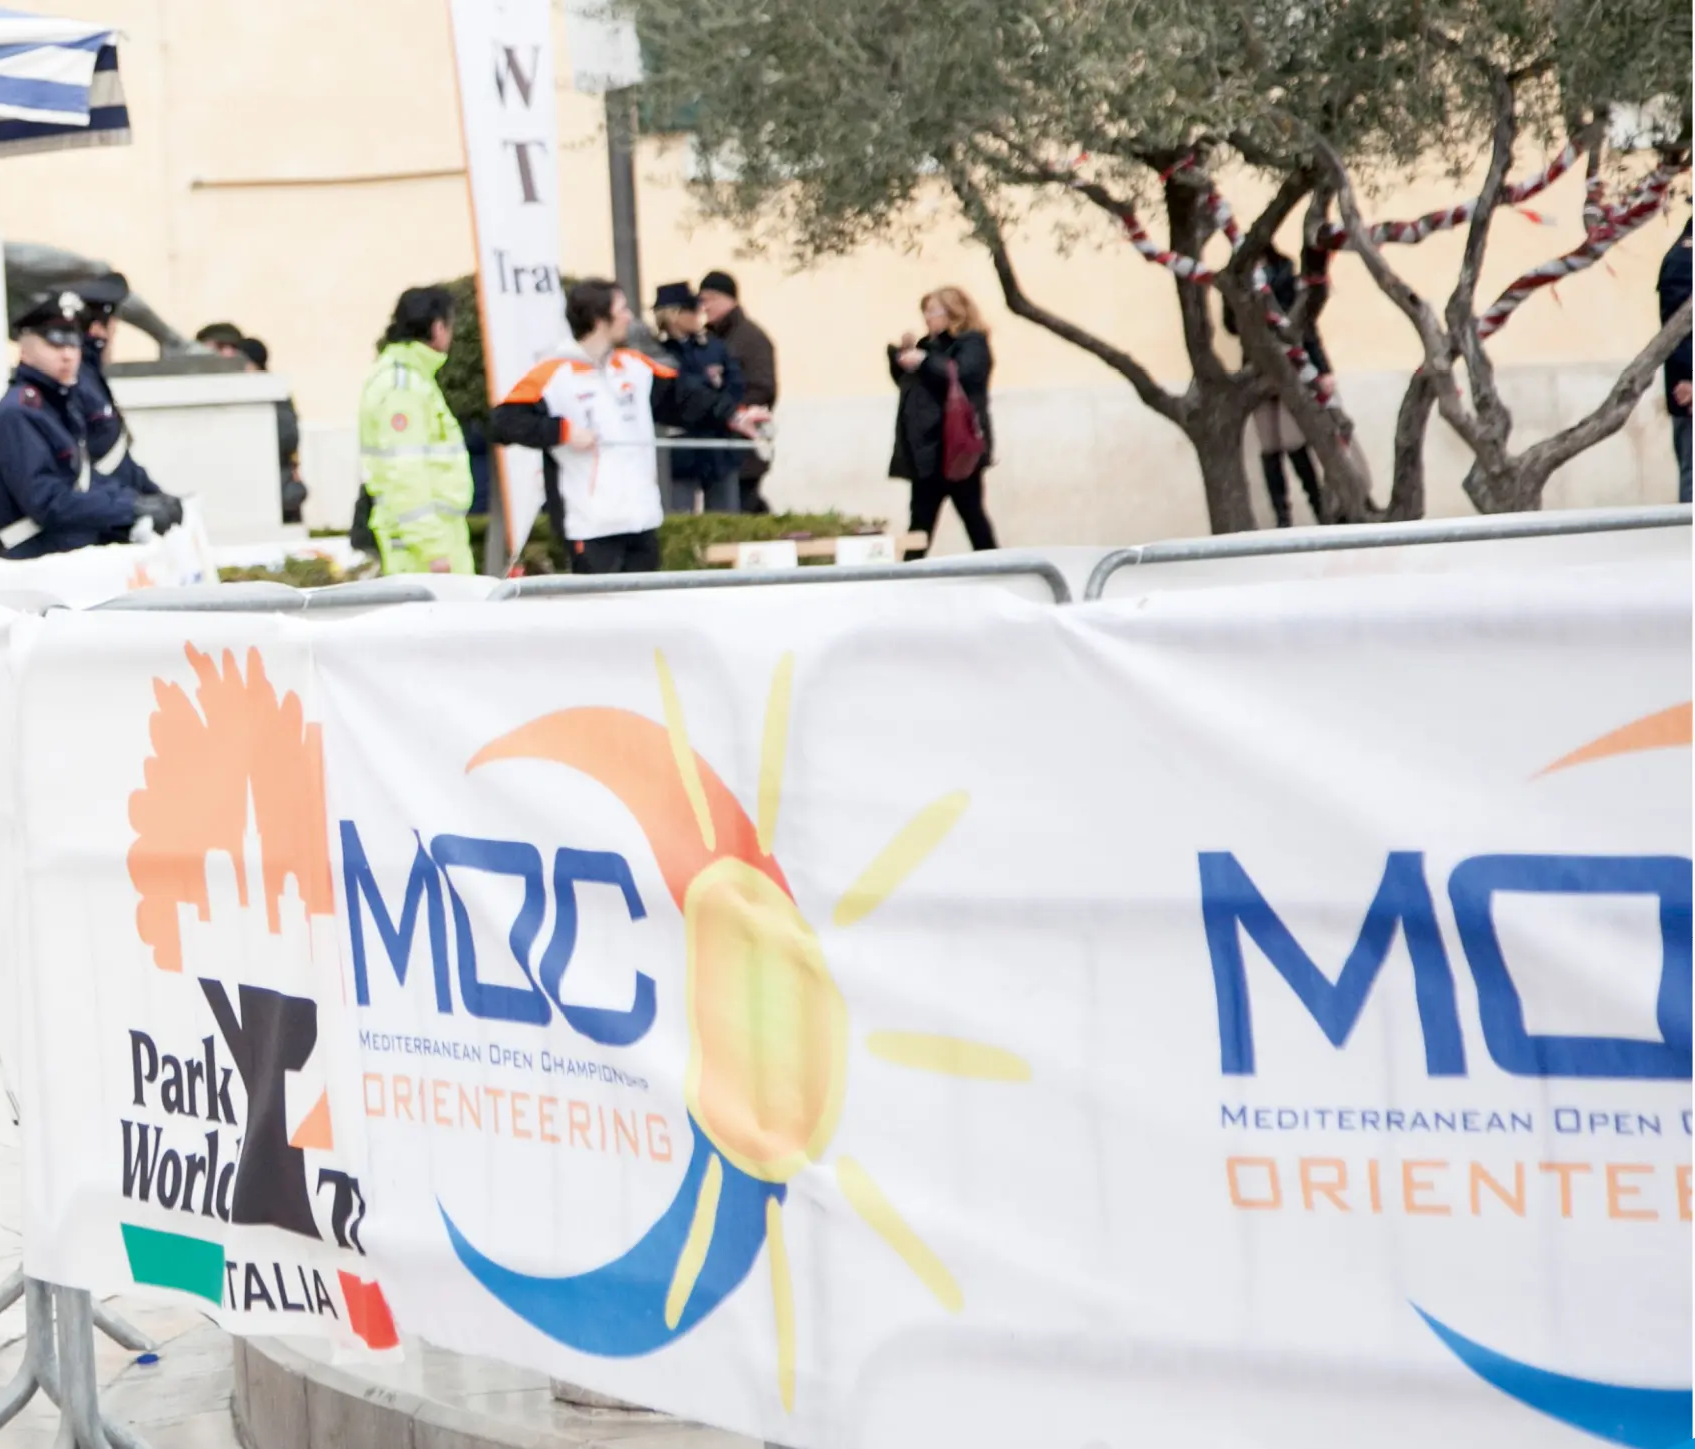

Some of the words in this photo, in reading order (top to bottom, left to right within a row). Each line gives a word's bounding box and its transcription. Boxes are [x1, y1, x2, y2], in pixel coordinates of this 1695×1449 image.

[339, 820, 657, 1047] MOC
[129, 1029, 238, 1126] Park
[362, 1071, 674, 1163] ORIENTEERING
[224, 1260, 339, 1319] TALIA
